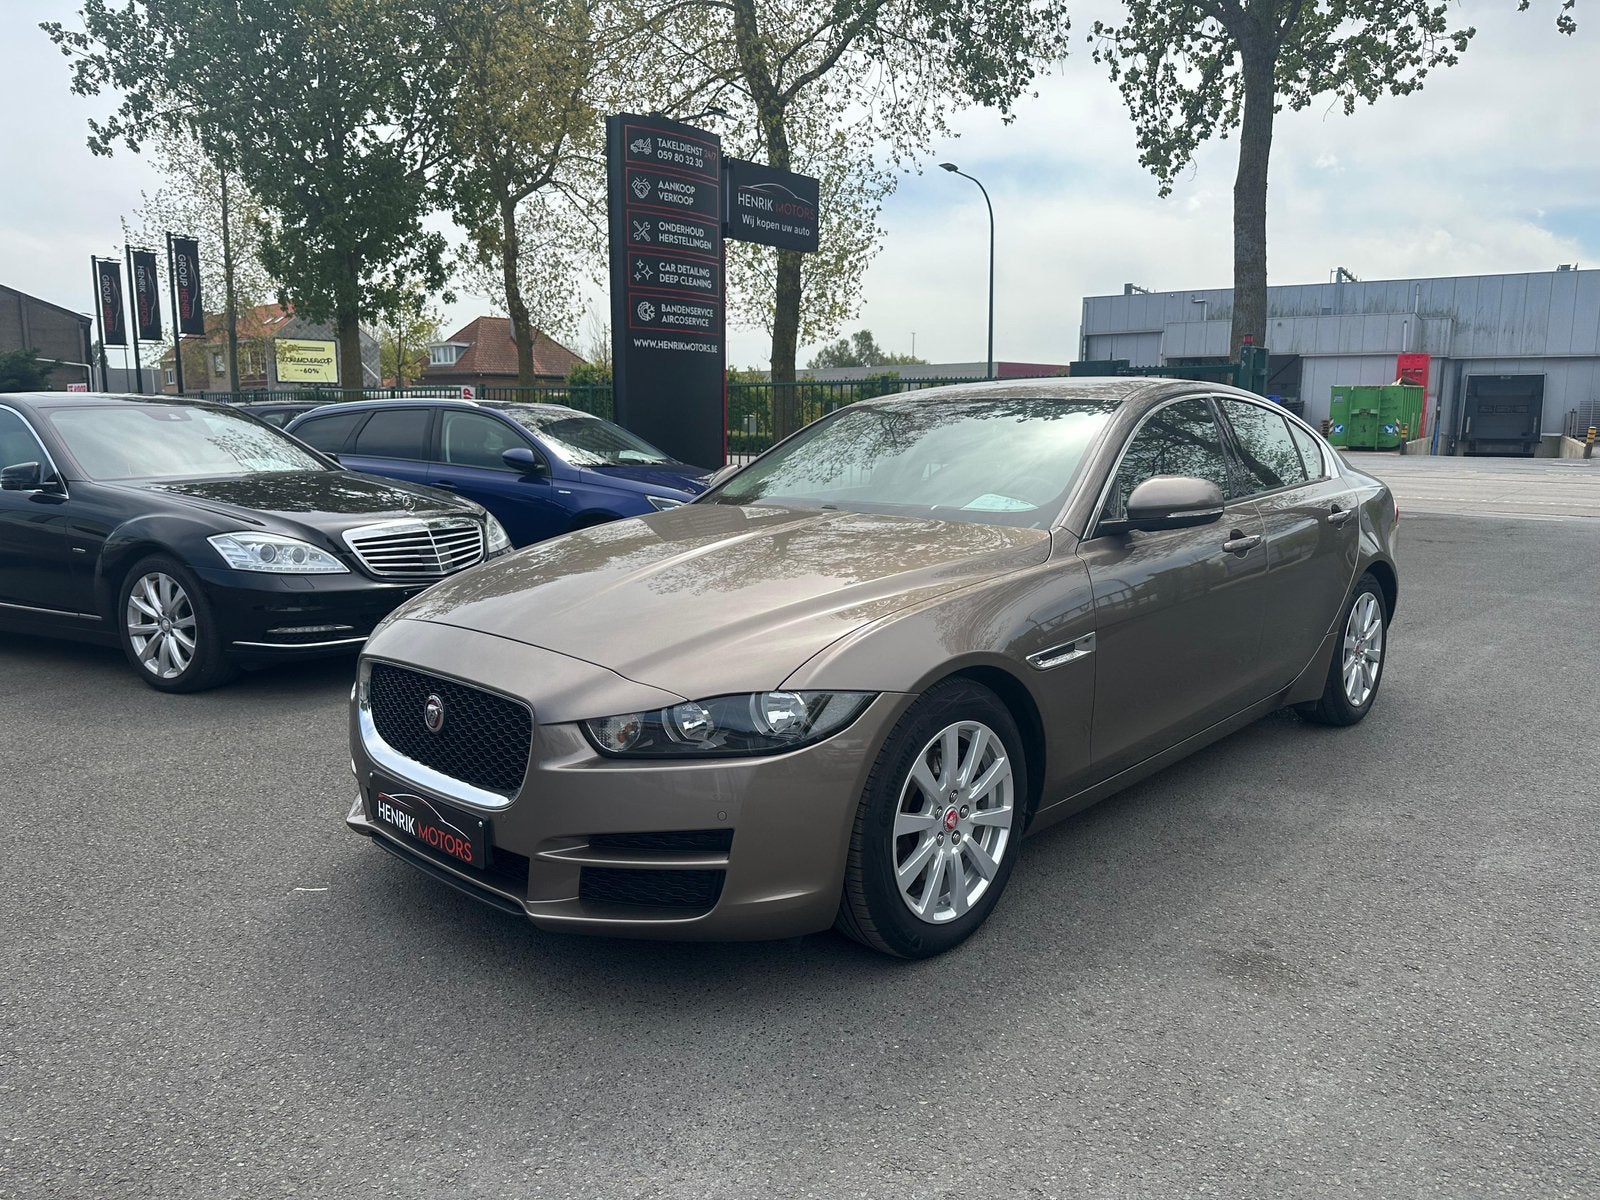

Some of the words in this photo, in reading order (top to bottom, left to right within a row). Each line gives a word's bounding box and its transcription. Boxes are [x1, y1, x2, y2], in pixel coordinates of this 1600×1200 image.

[657, 138, 703, 156] TAKELDIENST
[657, 150, 673, 161] 059
[674, 153, 684, 163] 80
[685, 155, 694, 166] 32
[695, 158, 704, 168] 30
[658, 180, 696, 195] AANKOOP
[658, 191, 694, 206] VERKOOP
[737, 192, 774, 212] HENRIK
[775, 203, 816, 220] MOTORS
[658, 221, 705, 238] ONDERHOUD
[741, 214, 755, 228] Wij
[756, 217, 780, 231] kopen
[781, 224, 793, 233] uw
[794, 226, 810, 236] auto
[658, 233, 712, 250] HERSTELLINGEN
[178, 254, 188, 287] GROUP
[659, 262, 676, 273] CAR
[677, 264, 710, 278] DETAILING
[137, 265, 147, 293] HENRIK
[659, 273, 679, 284] DEEP
[680, 276, 712, 289] CLEANING
[101, 274, 112, 304] GROUP
[180, 288, 190, 320] HENRIK
[661, 303, 714, 317] BANDENSERVICE
[661, 315, 709, 327] AIRCOSERVICE
[633, 338, 718, 353] WWW.HENRIKMOTORS.BE
[377, 800, 416, 836] HENRIK
[417, 822, 473, 862] MOTORS
